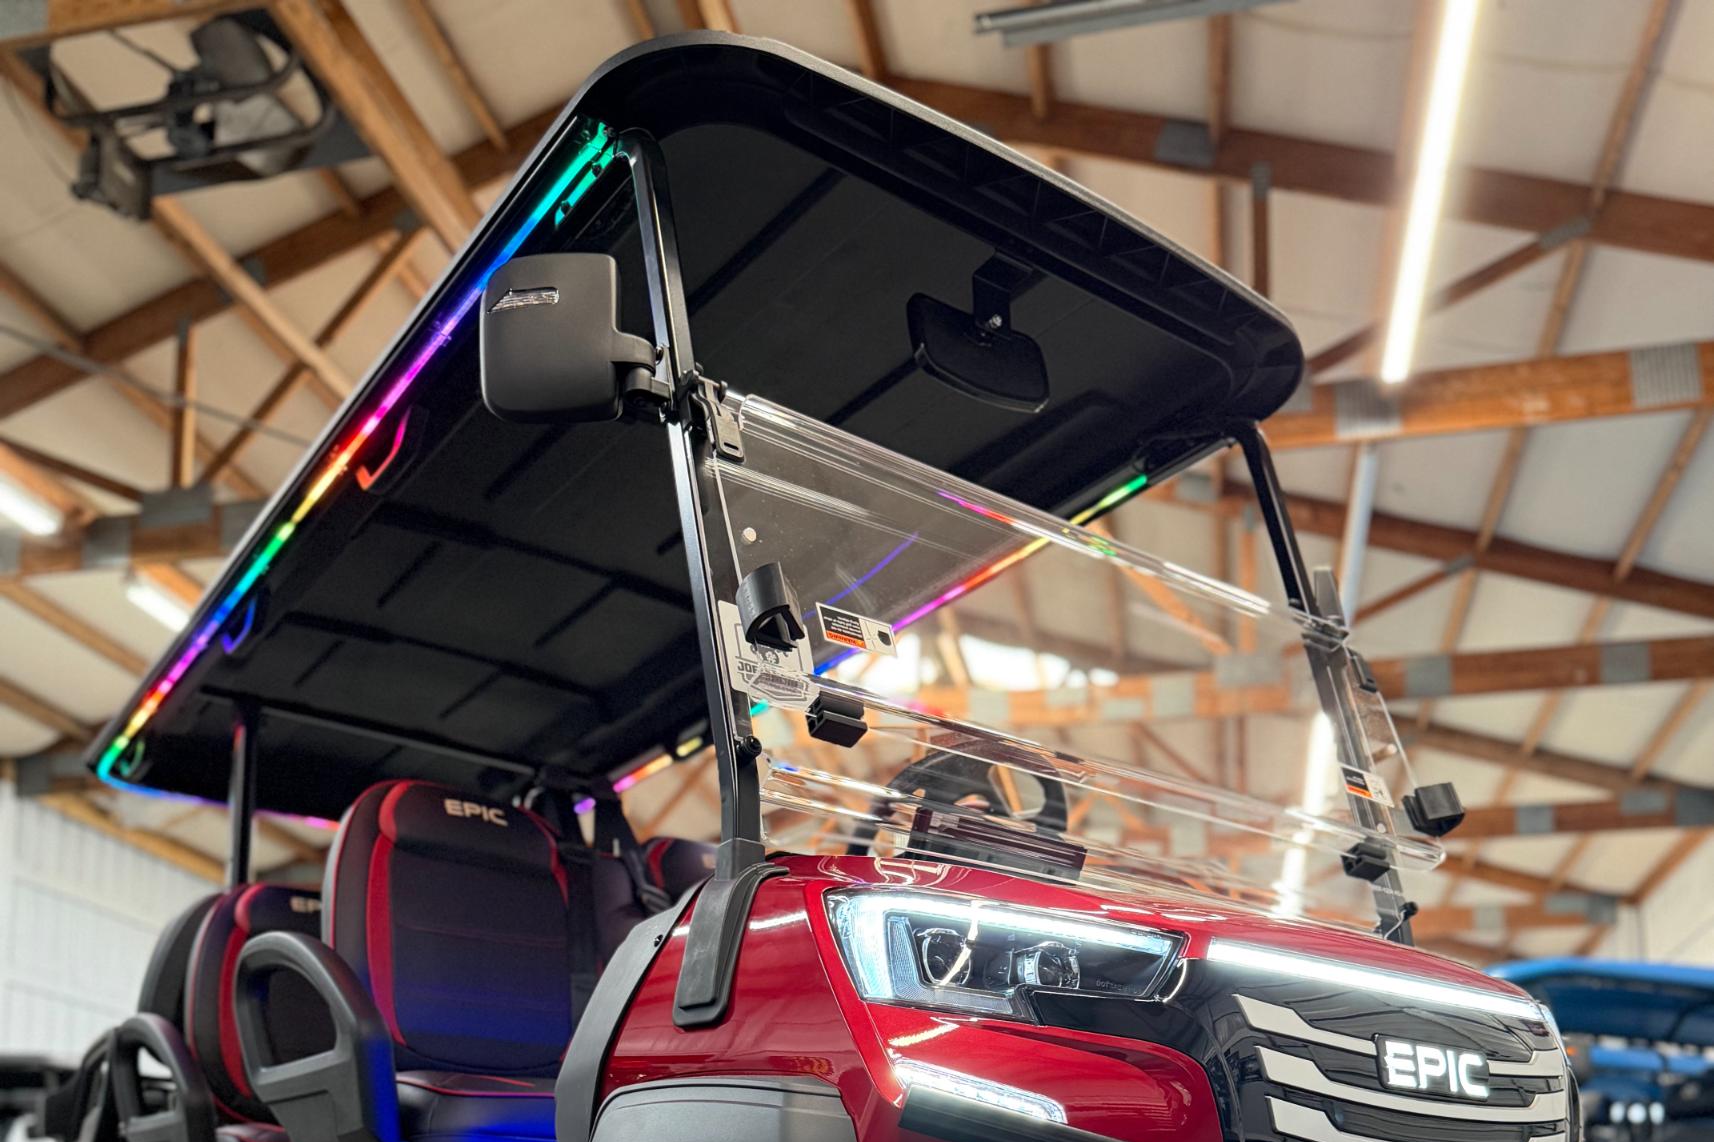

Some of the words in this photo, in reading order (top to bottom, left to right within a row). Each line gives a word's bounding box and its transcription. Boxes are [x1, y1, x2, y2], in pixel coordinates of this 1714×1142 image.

[443, 798, 509, 827] EPIC
[290, 896, 322, 914] EP
[1384, 1040, 1489, 1099] EPIC
